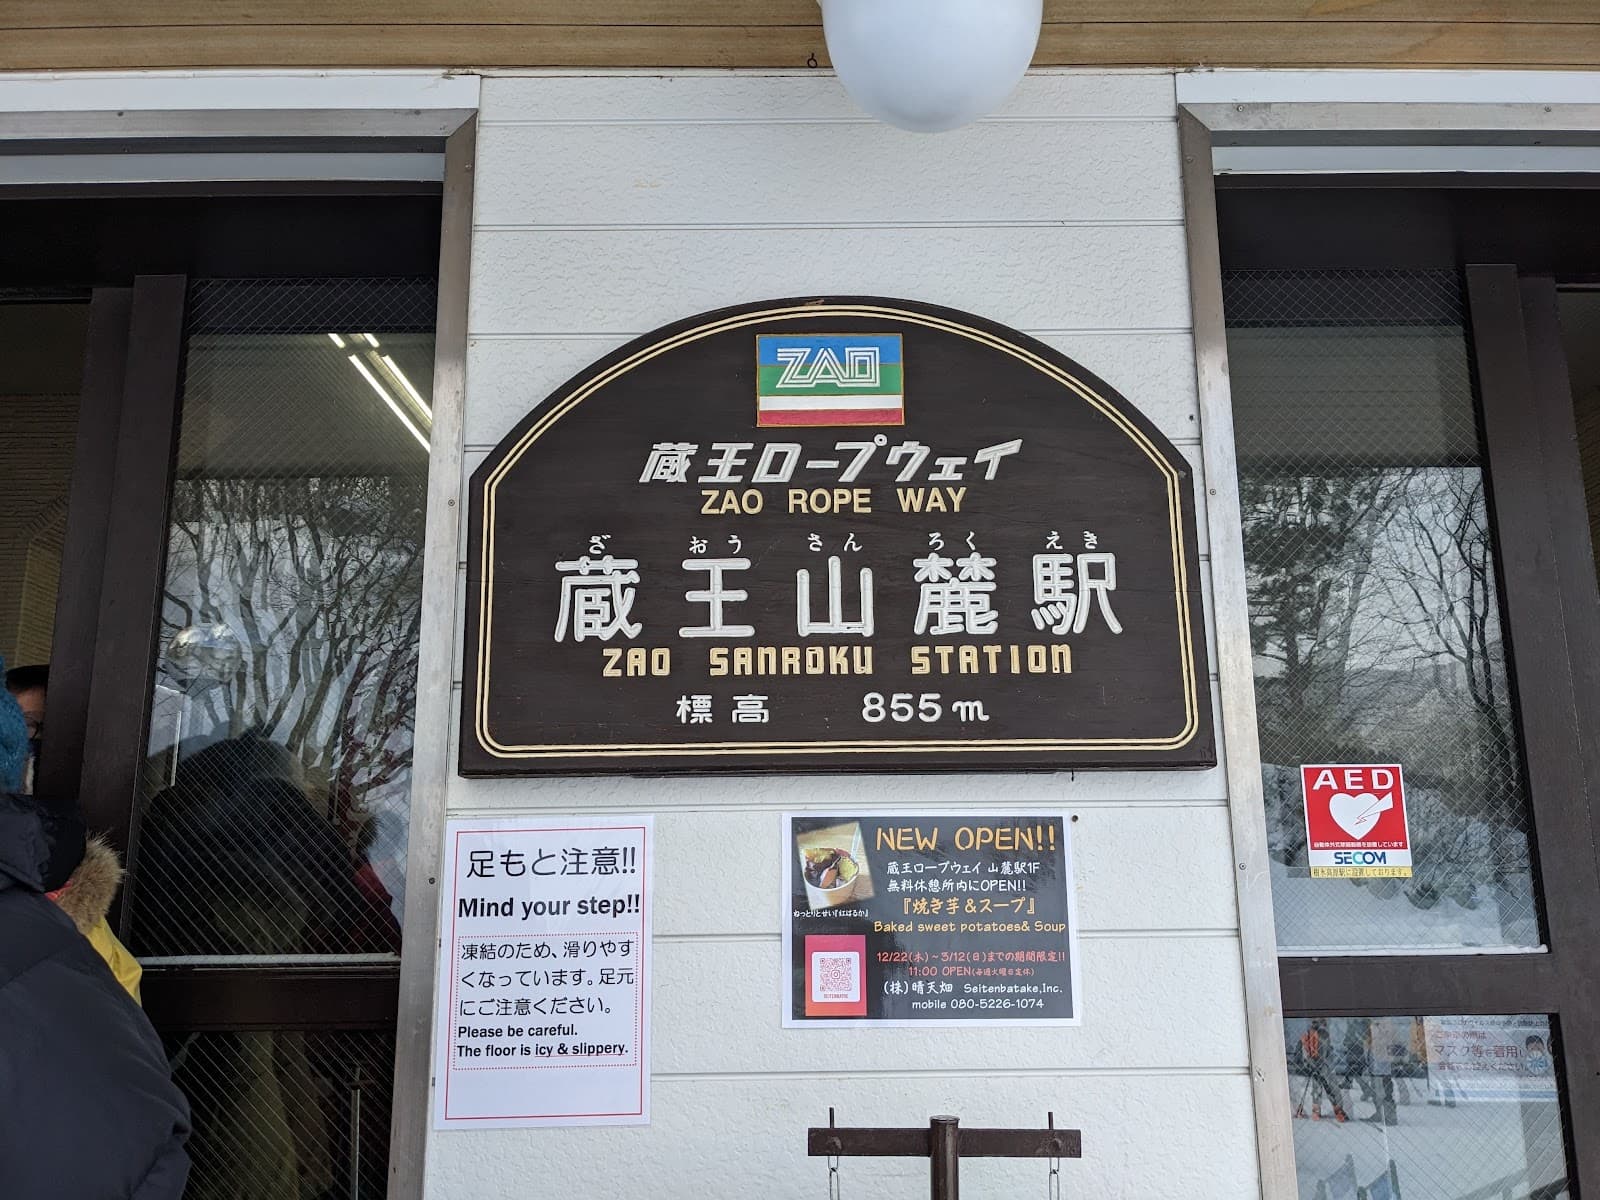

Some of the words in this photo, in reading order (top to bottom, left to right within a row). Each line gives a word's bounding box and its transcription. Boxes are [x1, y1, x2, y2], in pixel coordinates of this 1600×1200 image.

[776, 346, 881, 388] ZAO
[638, 434, 1023, 485] 蔵王ロープウェイ
[700, 489, 764, 515] ZAO
[788, 488, 872, 514] ROPE
[897, 487, 967, 513] WAY
[602, 648, 671, 677] ZAO
[709, 646, 873, 677] SANROKU
[911, 644, 1072, 675] STATION
[676, 694, 770, 724] 標高
[1312, 769, 1394, 790] AED
[876, 826, 938, 851] NEW
[954, 825, 1056, 851] OPEN!!
[466, 846, 637, 878] 足もと注意!!
[886, 861, 981, 875] 蔵王ロープウェイ
[1334, 851, 1387, 865] SECOM
[458, 897, 514, 918] Mind
[521, 901, 571, 921] your
[577, 894, 640, 918] step!!
[873, 920, 914, 933] Baked
[917, 921, 957, 932] sweet
[1034, 920, 1067, 934] Soup
[461, 940, 634, 961] 凍結のため、滑りやす
[461, 967, 634, 988] くなっています。足元
[908, 966, 938, 976] 11:00
[459, 998, 611, 1017] にご注意ください。
[911, 1000, 947, 1009] mobile
[950, 998, 1045, 1009] 080-5226-1074
[458, 1026, 503, 1038] Please
[507, 1025, 524, 1037] be
[527, 1024, 578, 1037] careful.
[457, 1045, 482, 1057] The
[485, 1045, 517, 1057] floor
[520, 1044, 531, 1056] is
[535, 1043, 554, 1057] icy
[557, 1042, 569, 1055] &
[572, 1042, 629, 1057] slippery.
